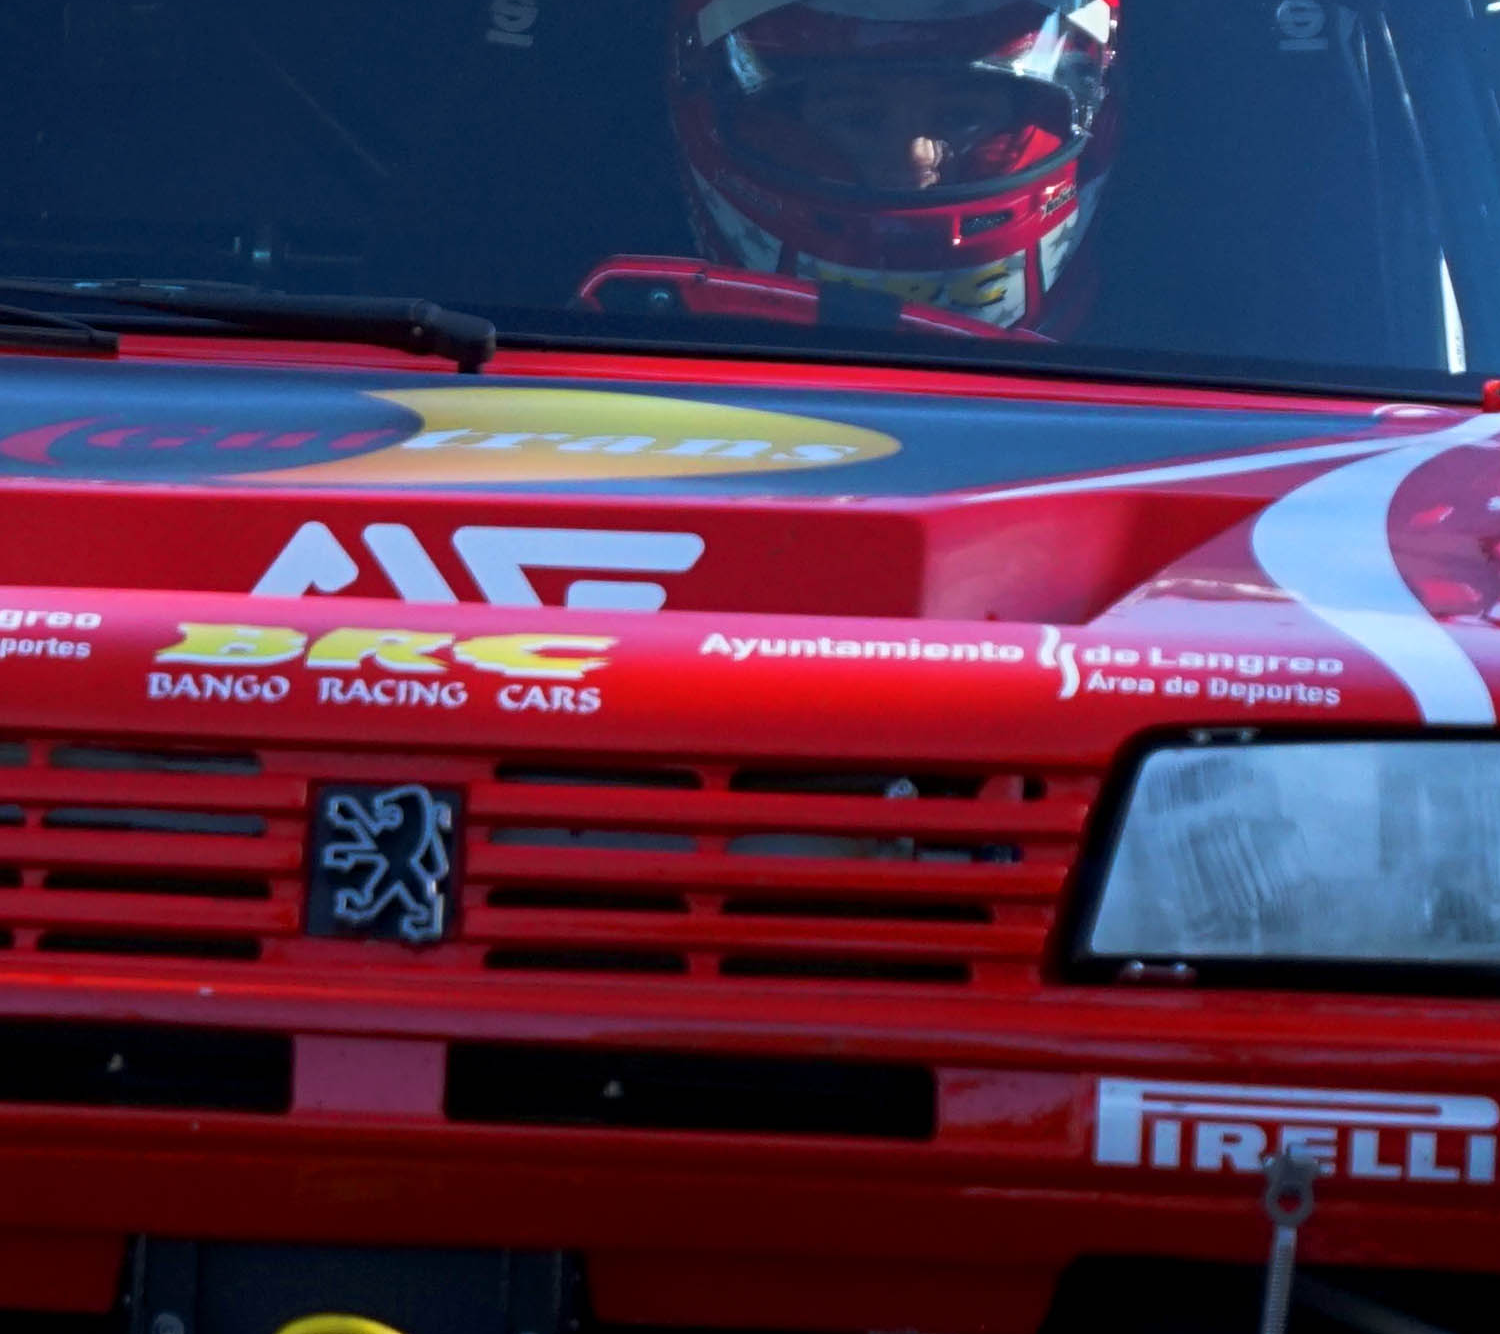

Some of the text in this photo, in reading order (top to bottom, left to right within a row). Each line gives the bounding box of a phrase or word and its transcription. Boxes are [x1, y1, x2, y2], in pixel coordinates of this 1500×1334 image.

[153, 622, 621, 680] BRC
[700, 632, 1345, 677] Ayuntamiento de Langreo
[147, 672, 601, 714] BANGO RACING CARS
[1086, 669, 1342, 706] Área de Deportes
[1094, 1075, 1500, 1184] PIRELLI
